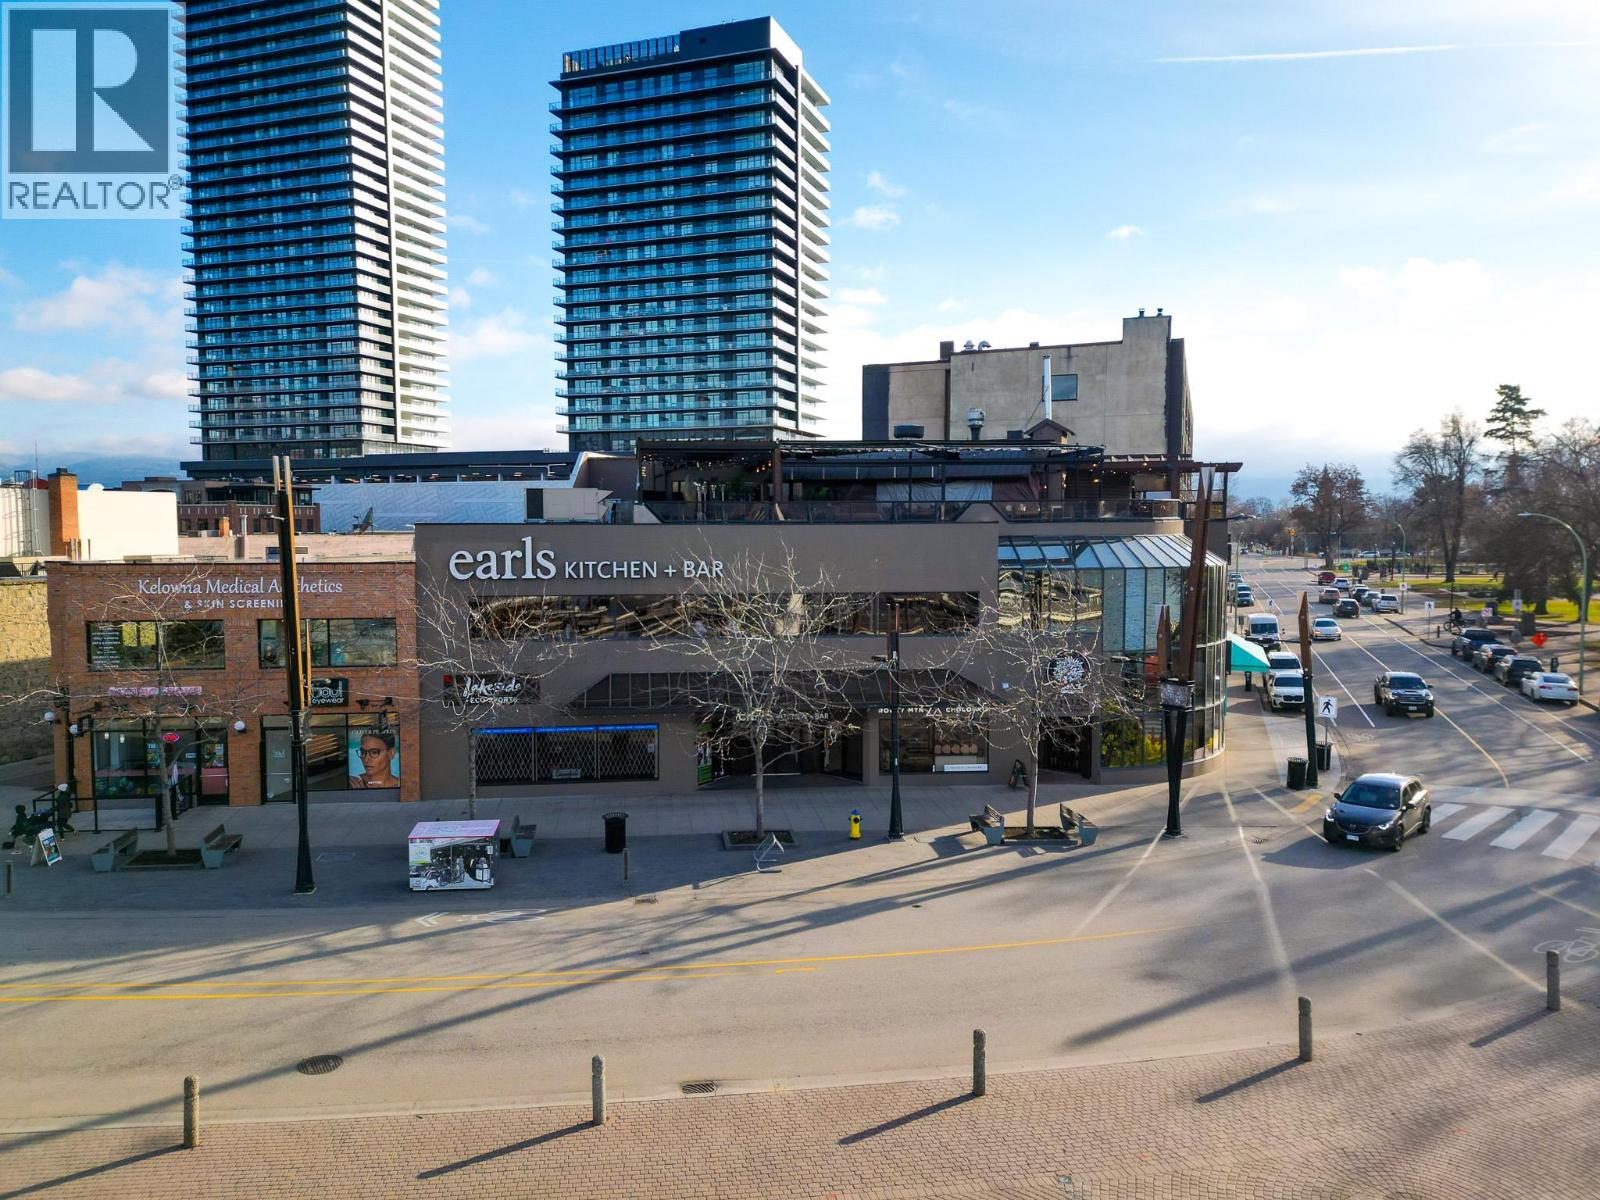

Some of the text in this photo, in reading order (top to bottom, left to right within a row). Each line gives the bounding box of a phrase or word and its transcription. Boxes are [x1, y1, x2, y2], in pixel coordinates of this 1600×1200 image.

[449, 536, 724, 580] earls KITCHEN + BAR
[138, 577, 201, 594] Kelowna
[206, 577, 264, 594] Medical
[197, 599, 224, 609] SKIN
